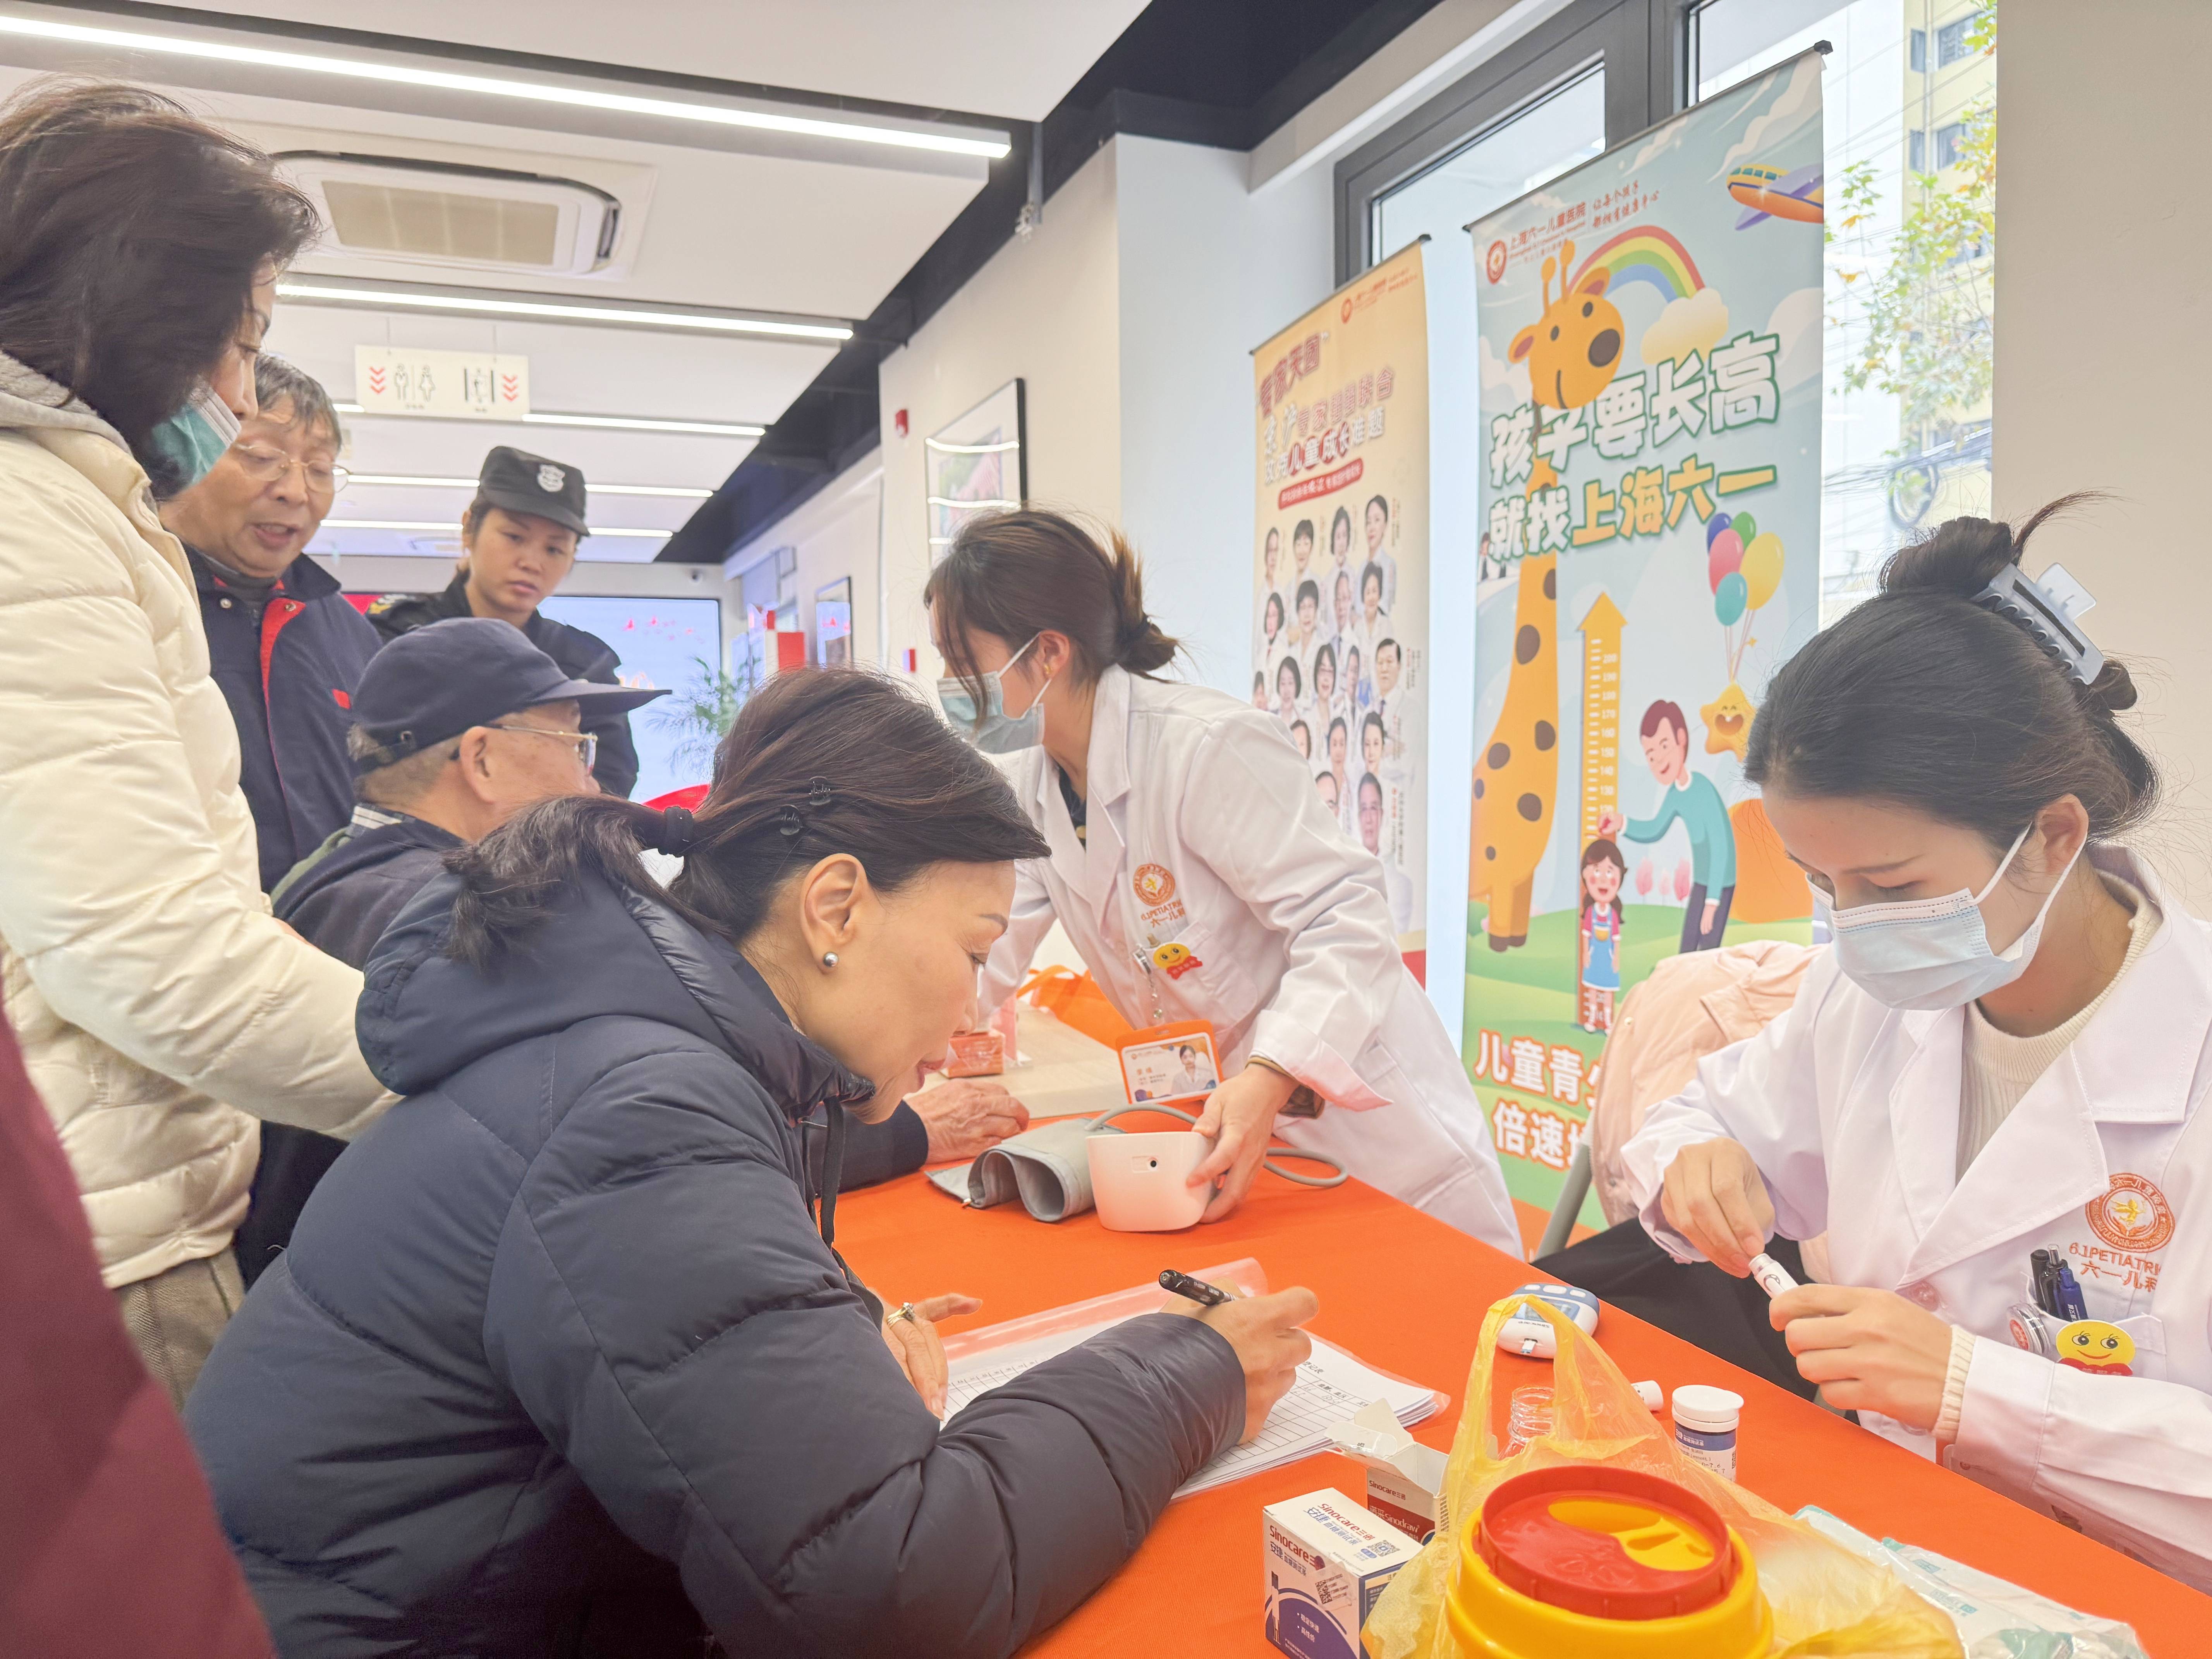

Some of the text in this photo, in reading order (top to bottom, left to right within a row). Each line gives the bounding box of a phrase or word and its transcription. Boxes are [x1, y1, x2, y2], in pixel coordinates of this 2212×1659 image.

[1510, 201, 1587, 249] 上海六一儿童医院
[1491, 331, 1780, 489] 孩子要长高
[1488, 454, 1776, 562] 就找上海六一
[1600, 766, 1614, 776] 140
[1303, 1506, 1331, 1523] 安捷
[1323, 1522, 1360, 1545] 血糖测试条
[1270, 1541, 1283, 1560] 安捷
